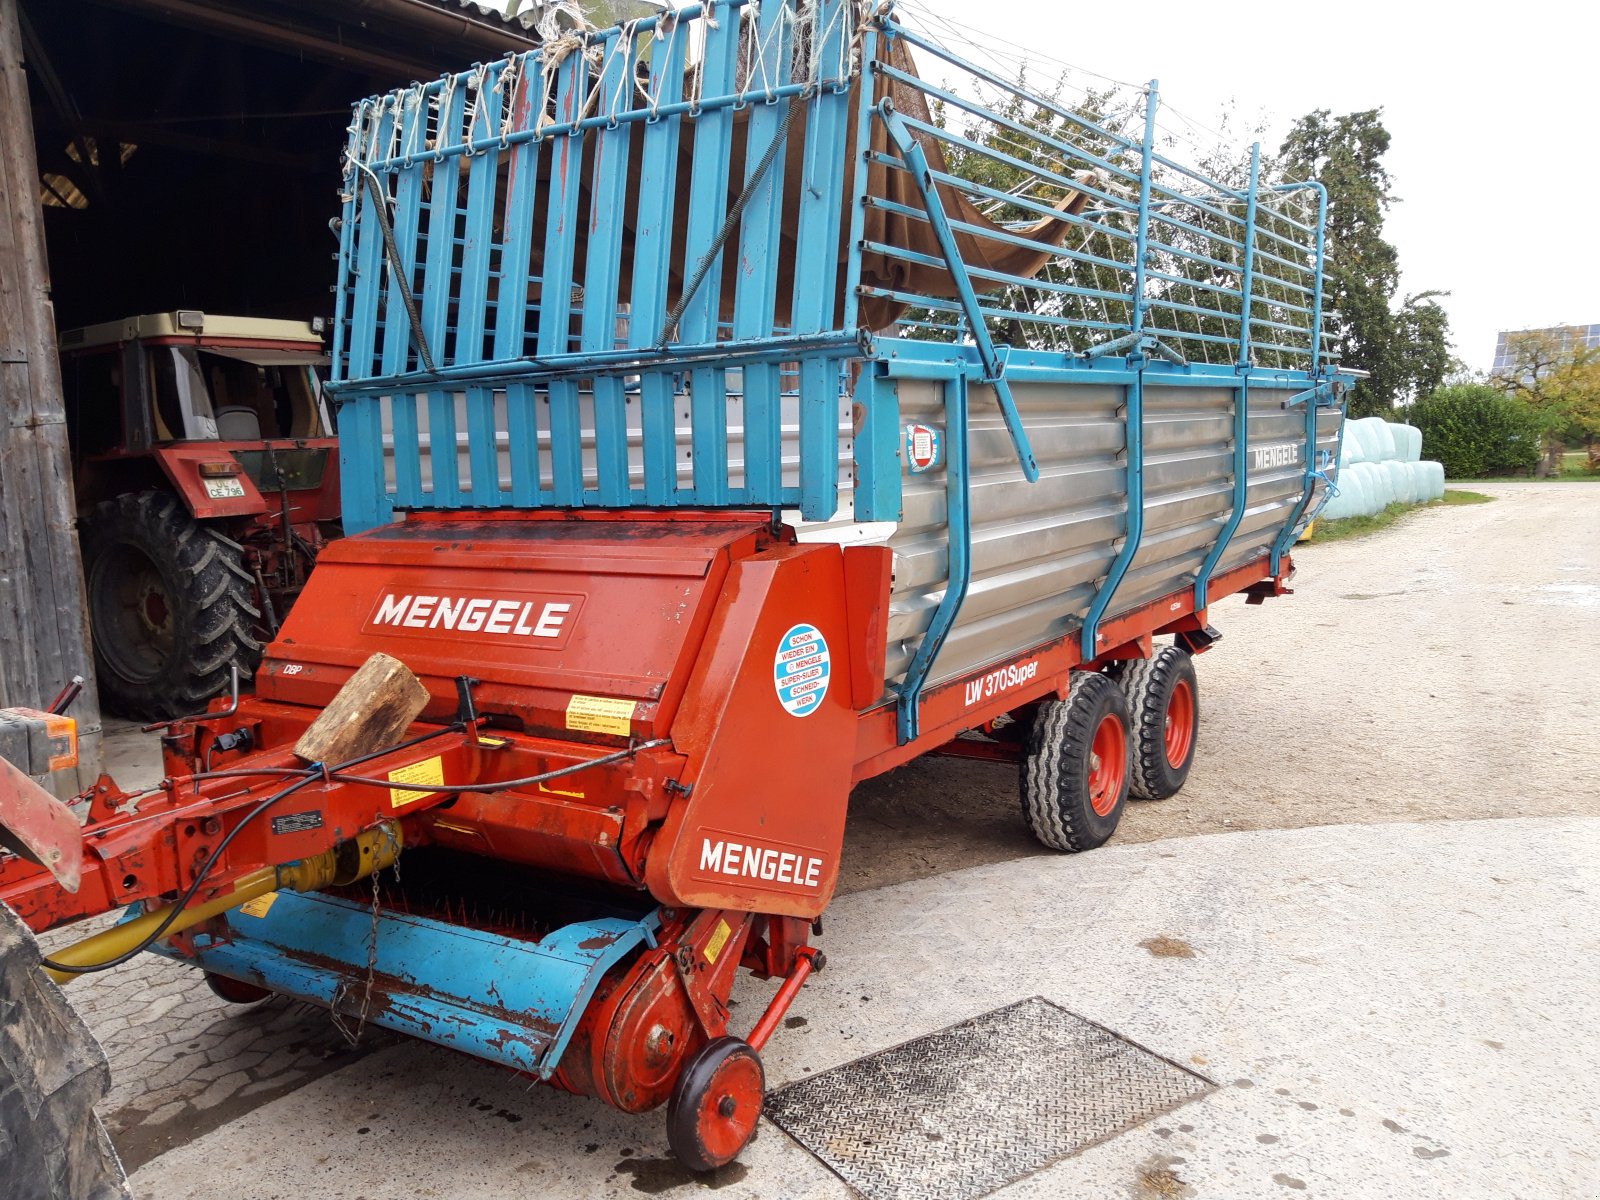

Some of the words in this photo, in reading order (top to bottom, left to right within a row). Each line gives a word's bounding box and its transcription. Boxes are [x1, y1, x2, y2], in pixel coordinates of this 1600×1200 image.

[1255, 444, 1298, 469] MENGELE
[373, 594, 571, 637] MENGELE
[791, 633, 813, 645] SCHON
[781, 648, 805, 661] WIEDER
[805, 644, 815, 655] EIN
[283, 664, 303, 675] DBP
[795, 654, 822, 669] MENGELE
[792, 681, 820, 696] SCHNEID-
[965, 677, 984, 706] LW
[796, 695, 814, 707] WERK
[699, 838, 823, 887] MENGELE
